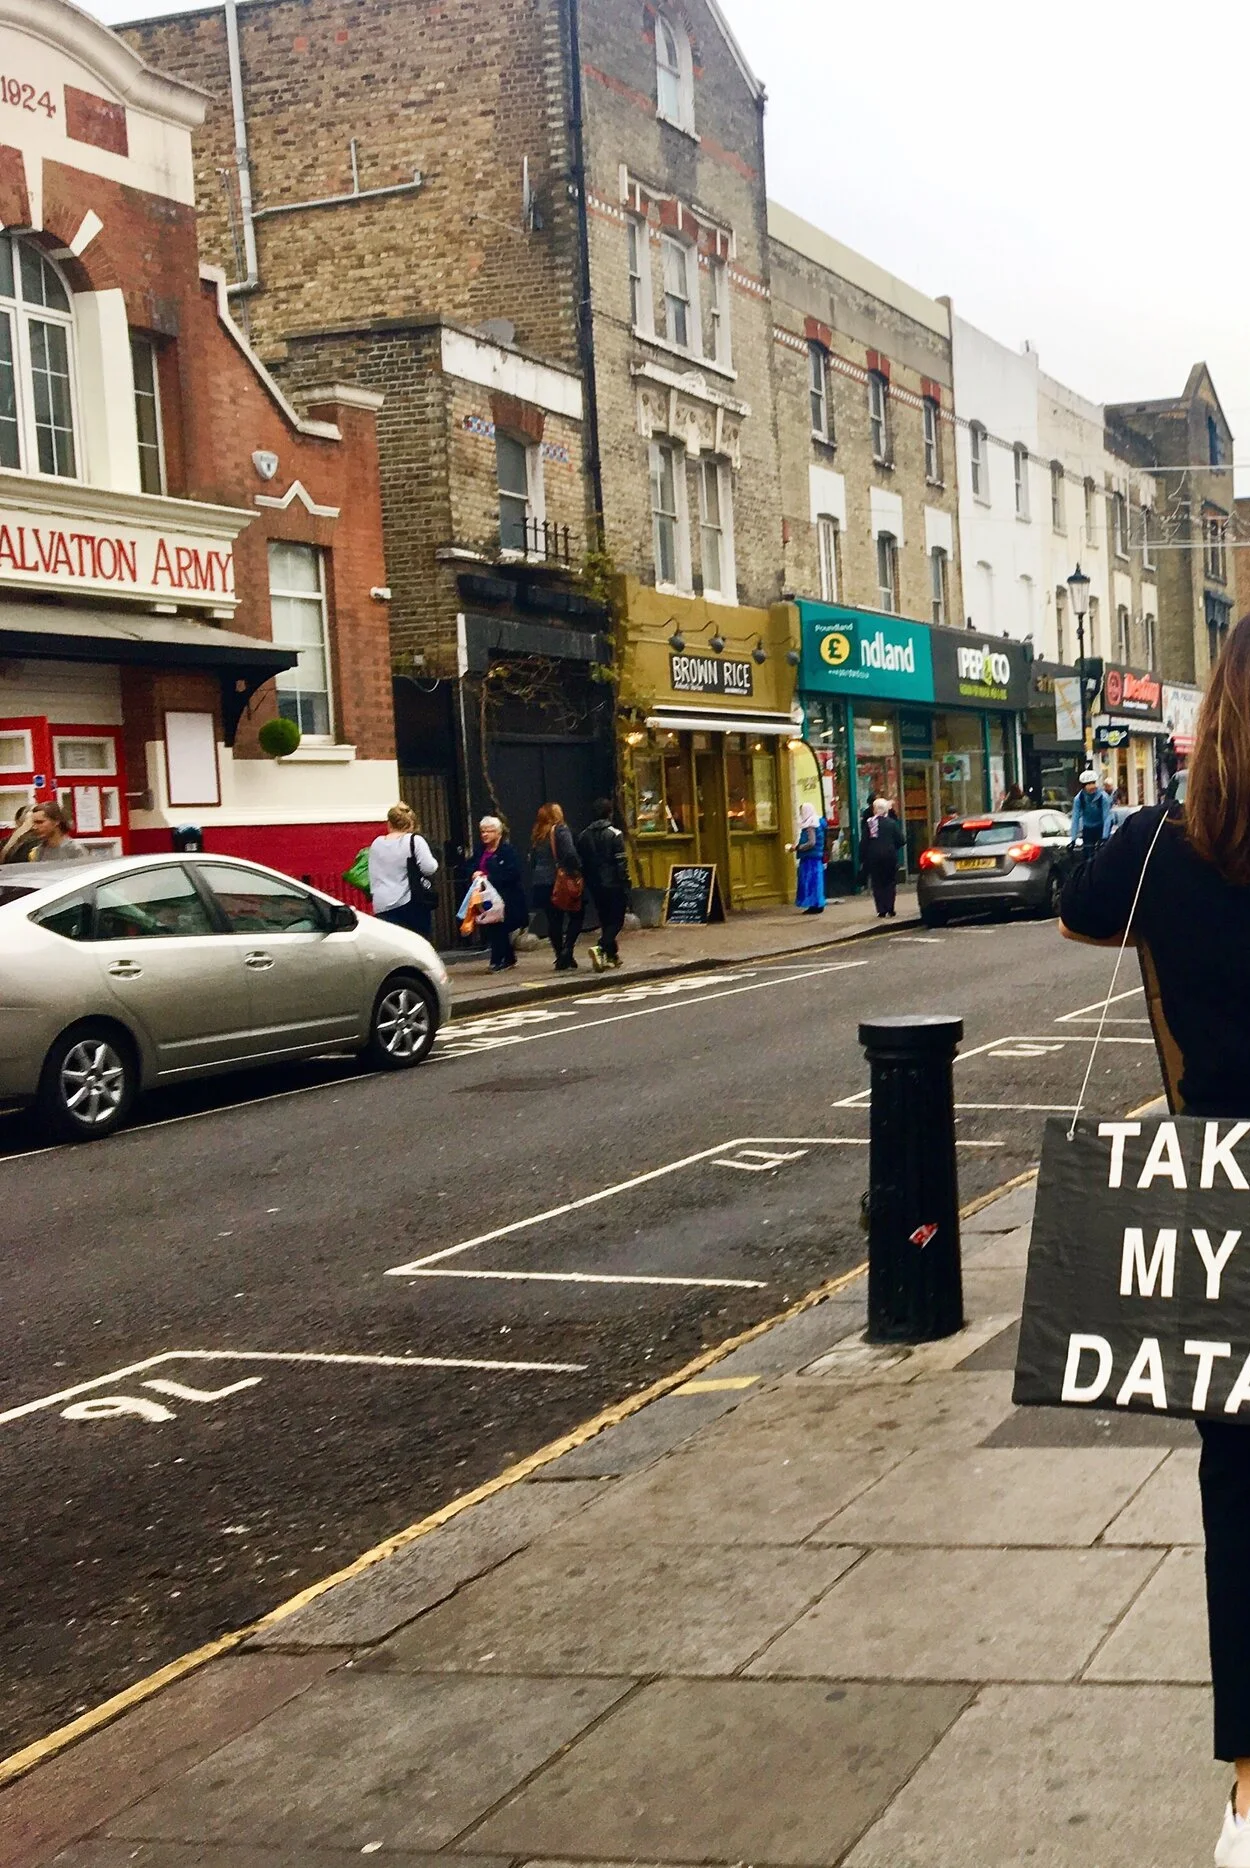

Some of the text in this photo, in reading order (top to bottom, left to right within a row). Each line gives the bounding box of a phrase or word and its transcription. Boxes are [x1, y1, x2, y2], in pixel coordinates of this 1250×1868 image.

[1, 75, 56, 118] 1924
[0, 525, 137, 582] ALVATION
[672, 656, 751, 688] BROWN RICE
[860, 631, 915, 673] ndland
[1119, 1227, 1242, 1300] MY
